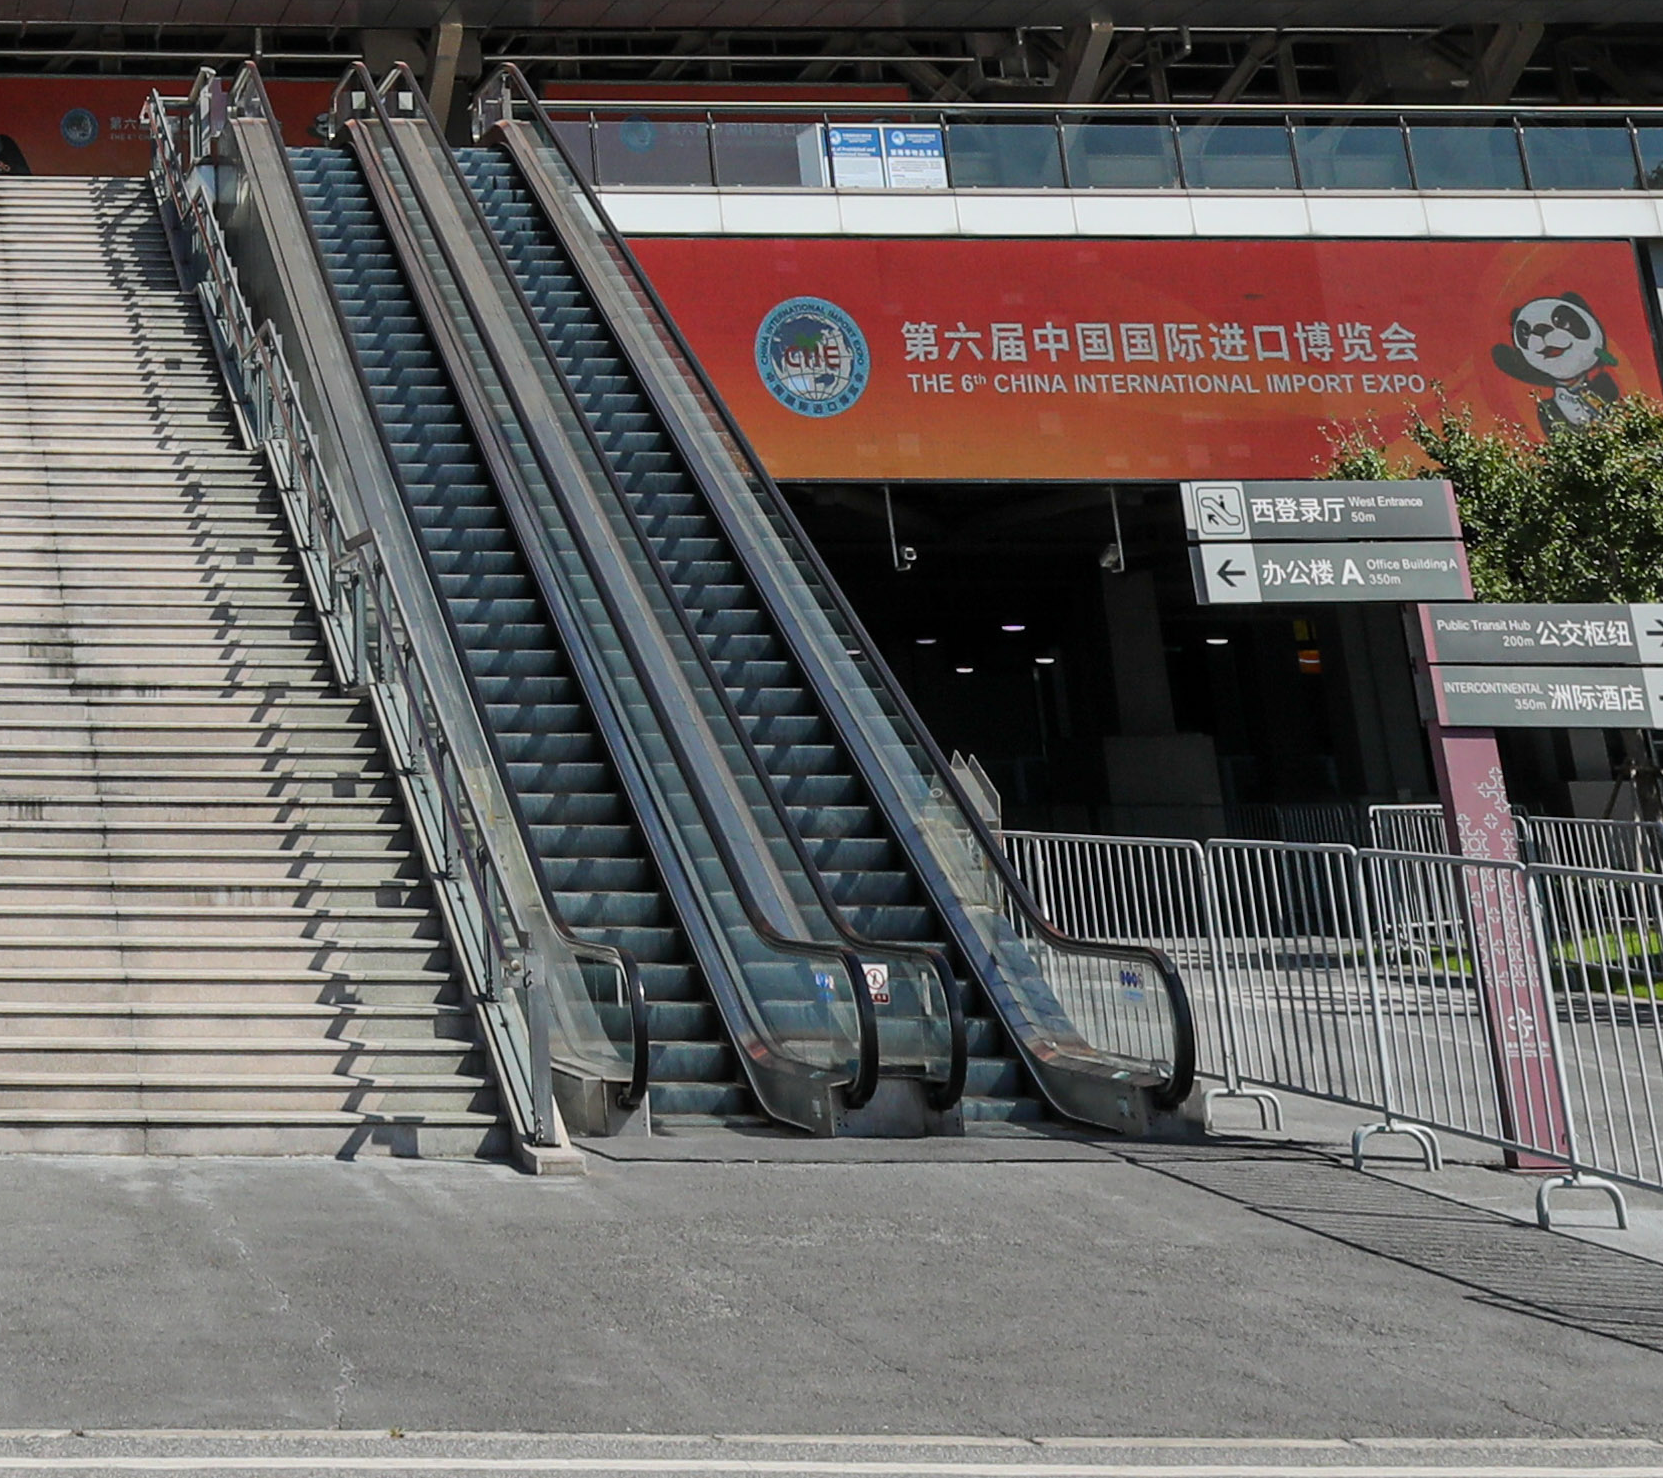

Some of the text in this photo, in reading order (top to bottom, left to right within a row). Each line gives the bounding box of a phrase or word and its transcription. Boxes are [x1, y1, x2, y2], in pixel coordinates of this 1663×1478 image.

[901, 321, 1419, 363] 第六届中国国际进口博览会
[907, 373, 1426, 394] THE 6th CHINA INTERNATIONAL IMPORT EXPO
[1348, 496, 1423, 507] West Entrance
[1249, 497, 1345, 524] 西登录厅
[1350, 512, 1376, 523] 50m
[1366, 558, 1458, 572] Office Building A
[1262, 559, 1365, 586] 办公楼 A
[1369, 574, 1401, 586] 350m
[1437, 619, 1531, 631] Public Transit Hub
[1536, 620, 1633, 647] 公交枢纽
[1502, 636, 1535, 647] 200m
[1444, 682, 1543, 694] INTERCONTINENTAL
[1547, 683, 1645, 712] 洲际酒店
[1515, 699, 1547, 710] 350m
